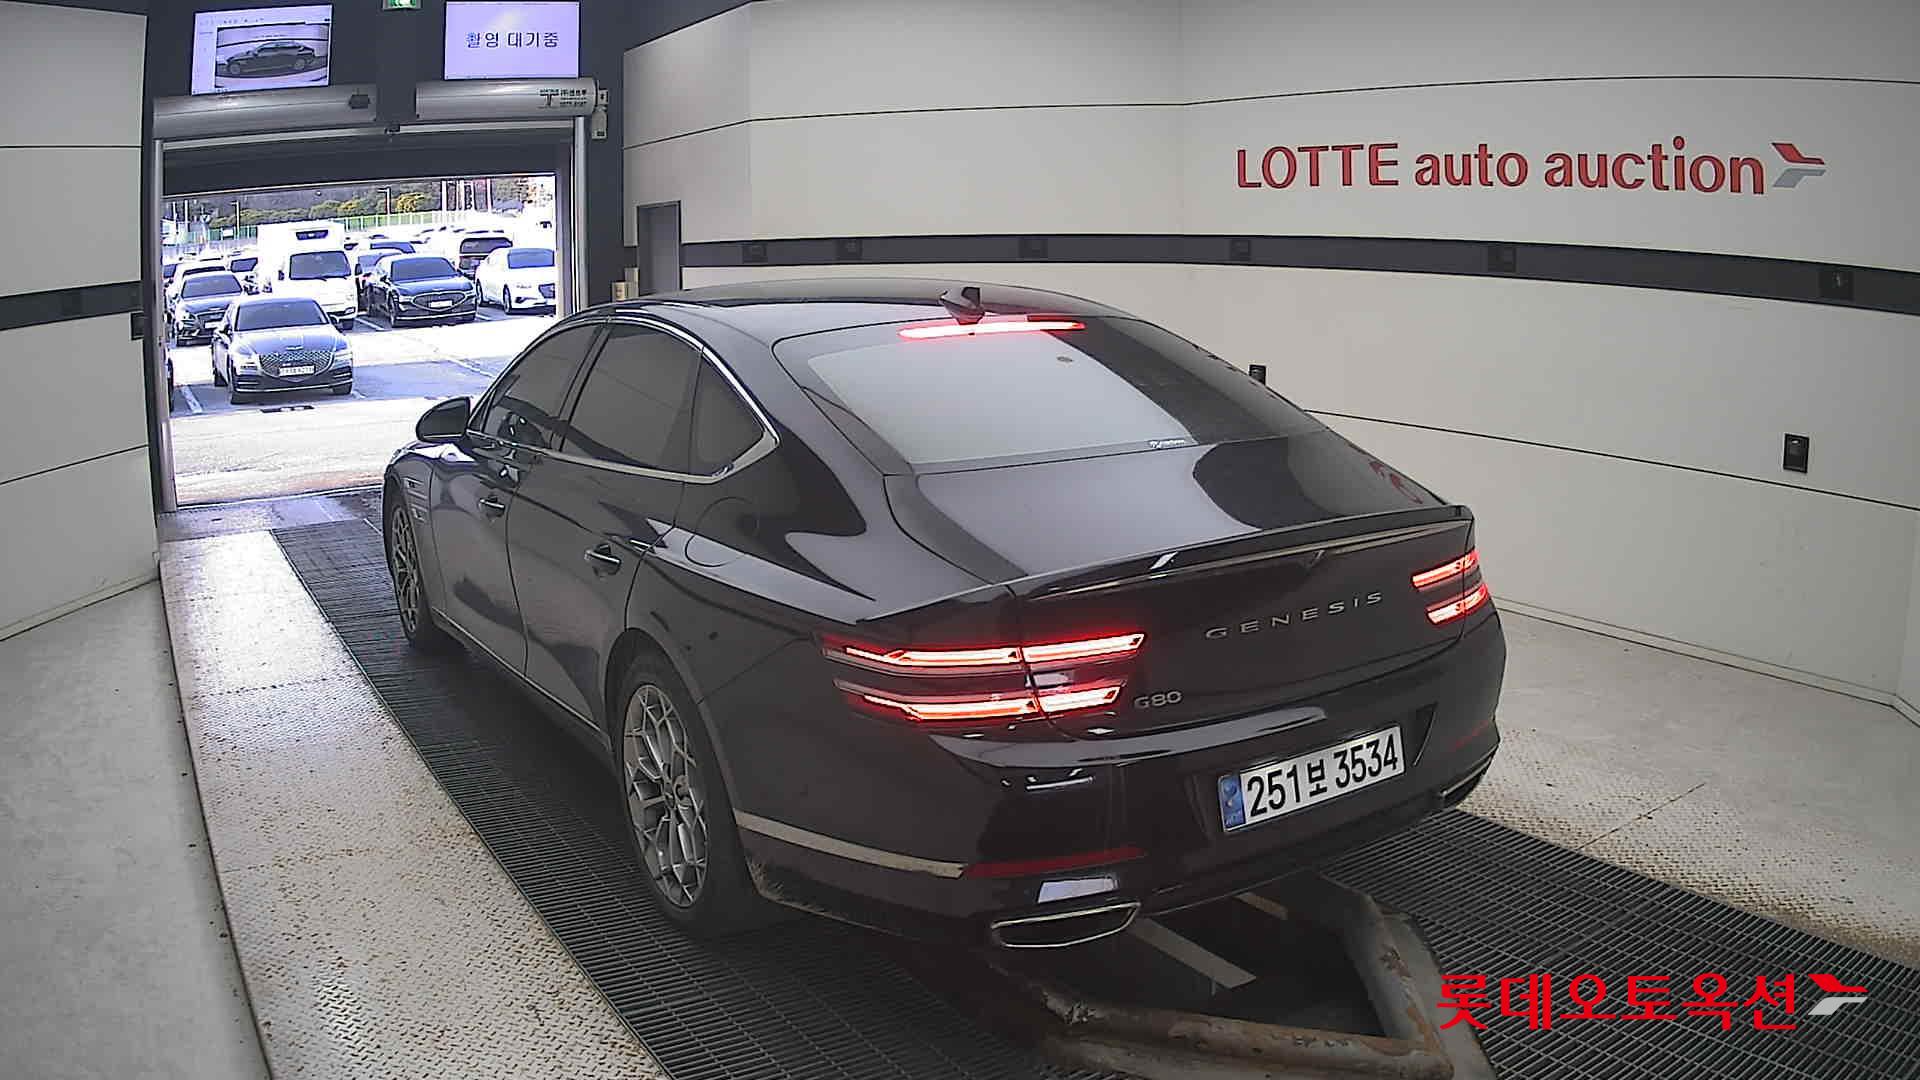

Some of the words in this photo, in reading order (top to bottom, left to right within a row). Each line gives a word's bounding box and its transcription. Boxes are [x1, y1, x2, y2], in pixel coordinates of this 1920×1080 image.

[507, 31, 559, 48] 대기중
[1237, 142, 1399, 189] LOTTE
[1414, 143, 1529, 188] auto
[1543, 135, 1766, 196] auction
[1205, 591, 1383, 639] GENESIS
[1133, 690, 1183, 710] G80
[1247, 758, 1328, 818] 251보
[1333, 733, 1399, 789] 3534
